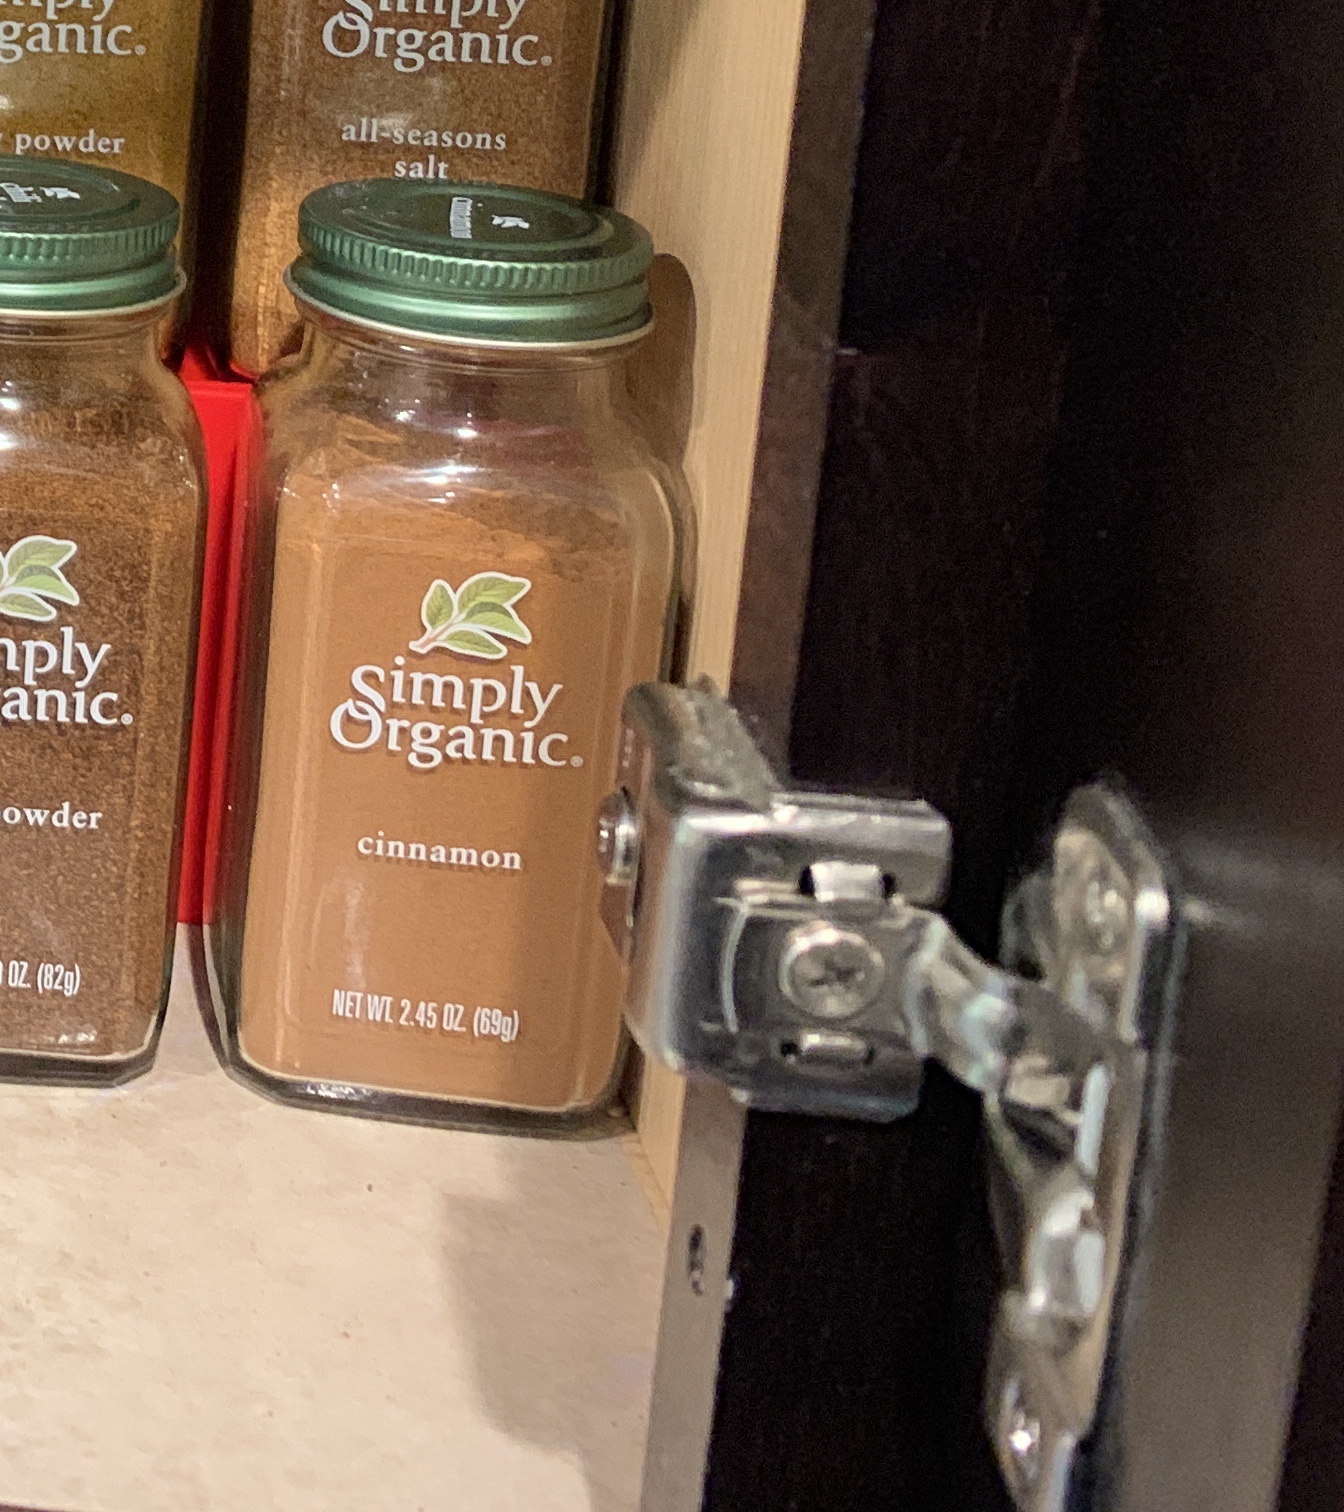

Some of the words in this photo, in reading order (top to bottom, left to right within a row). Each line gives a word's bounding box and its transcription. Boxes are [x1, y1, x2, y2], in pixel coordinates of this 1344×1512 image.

[322, 11, 540, 72] Organic
[15, 129, 126, 155] powder
[341, 118, 507, 149] all-seasons
[394, 155, 449, 178] salt
[350, 656, 564, 728] Simply
[330, 698, 568, 769] Organic
[357, 831, 522, 870] cinnamon
[8, 960, 31, 988] OZ.
[37, 962, 81, 997] (82g)
[332, 989, 364, 1019] NET
[367, 993, 394, 1024] WT.
[399, 998, 438, 1029] 2.45
[442, 1003, 466, 1032] OZ.
[473, 1006, 519, 1043] (69g)
